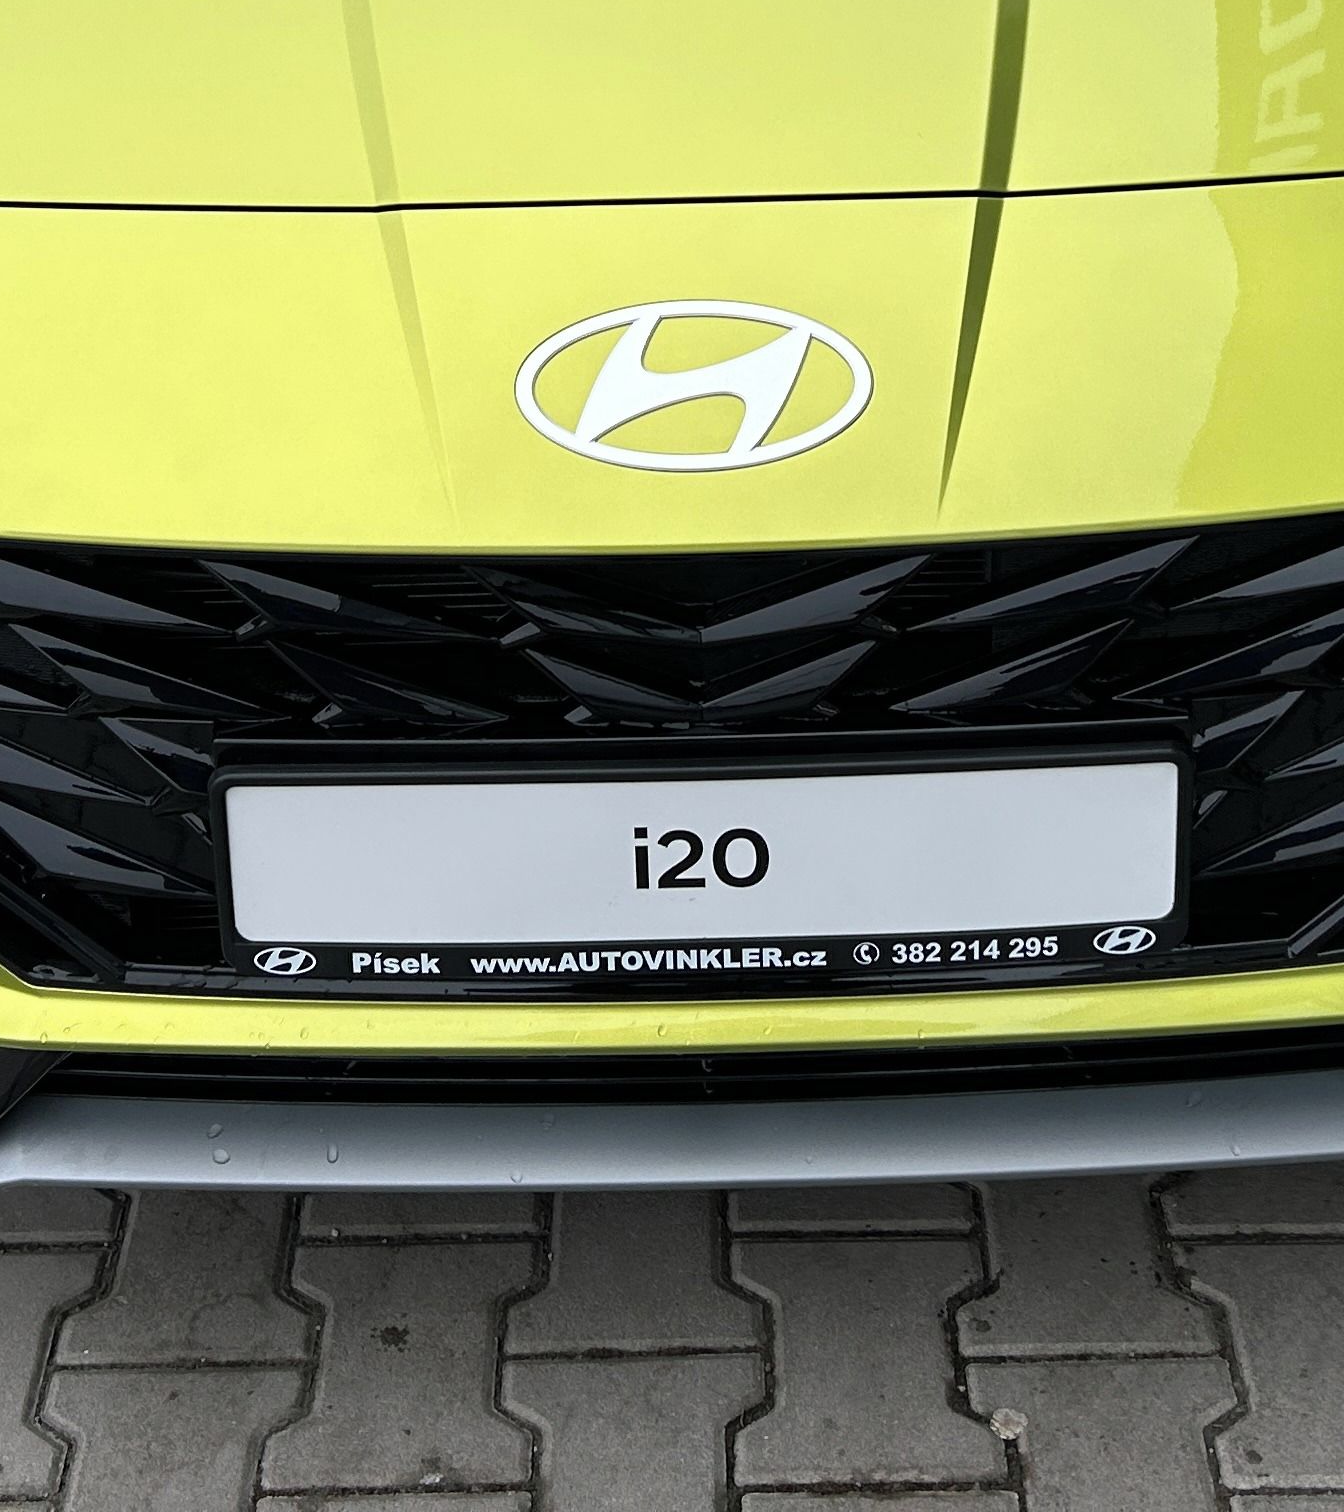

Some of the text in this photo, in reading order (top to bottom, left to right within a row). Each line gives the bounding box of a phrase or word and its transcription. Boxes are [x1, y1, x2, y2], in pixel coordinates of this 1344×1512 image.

[633, 826, 770, 890] i20
[352, 935, 1059, 975] Písek www.AUTOVINKLER.cz 382 214 295
